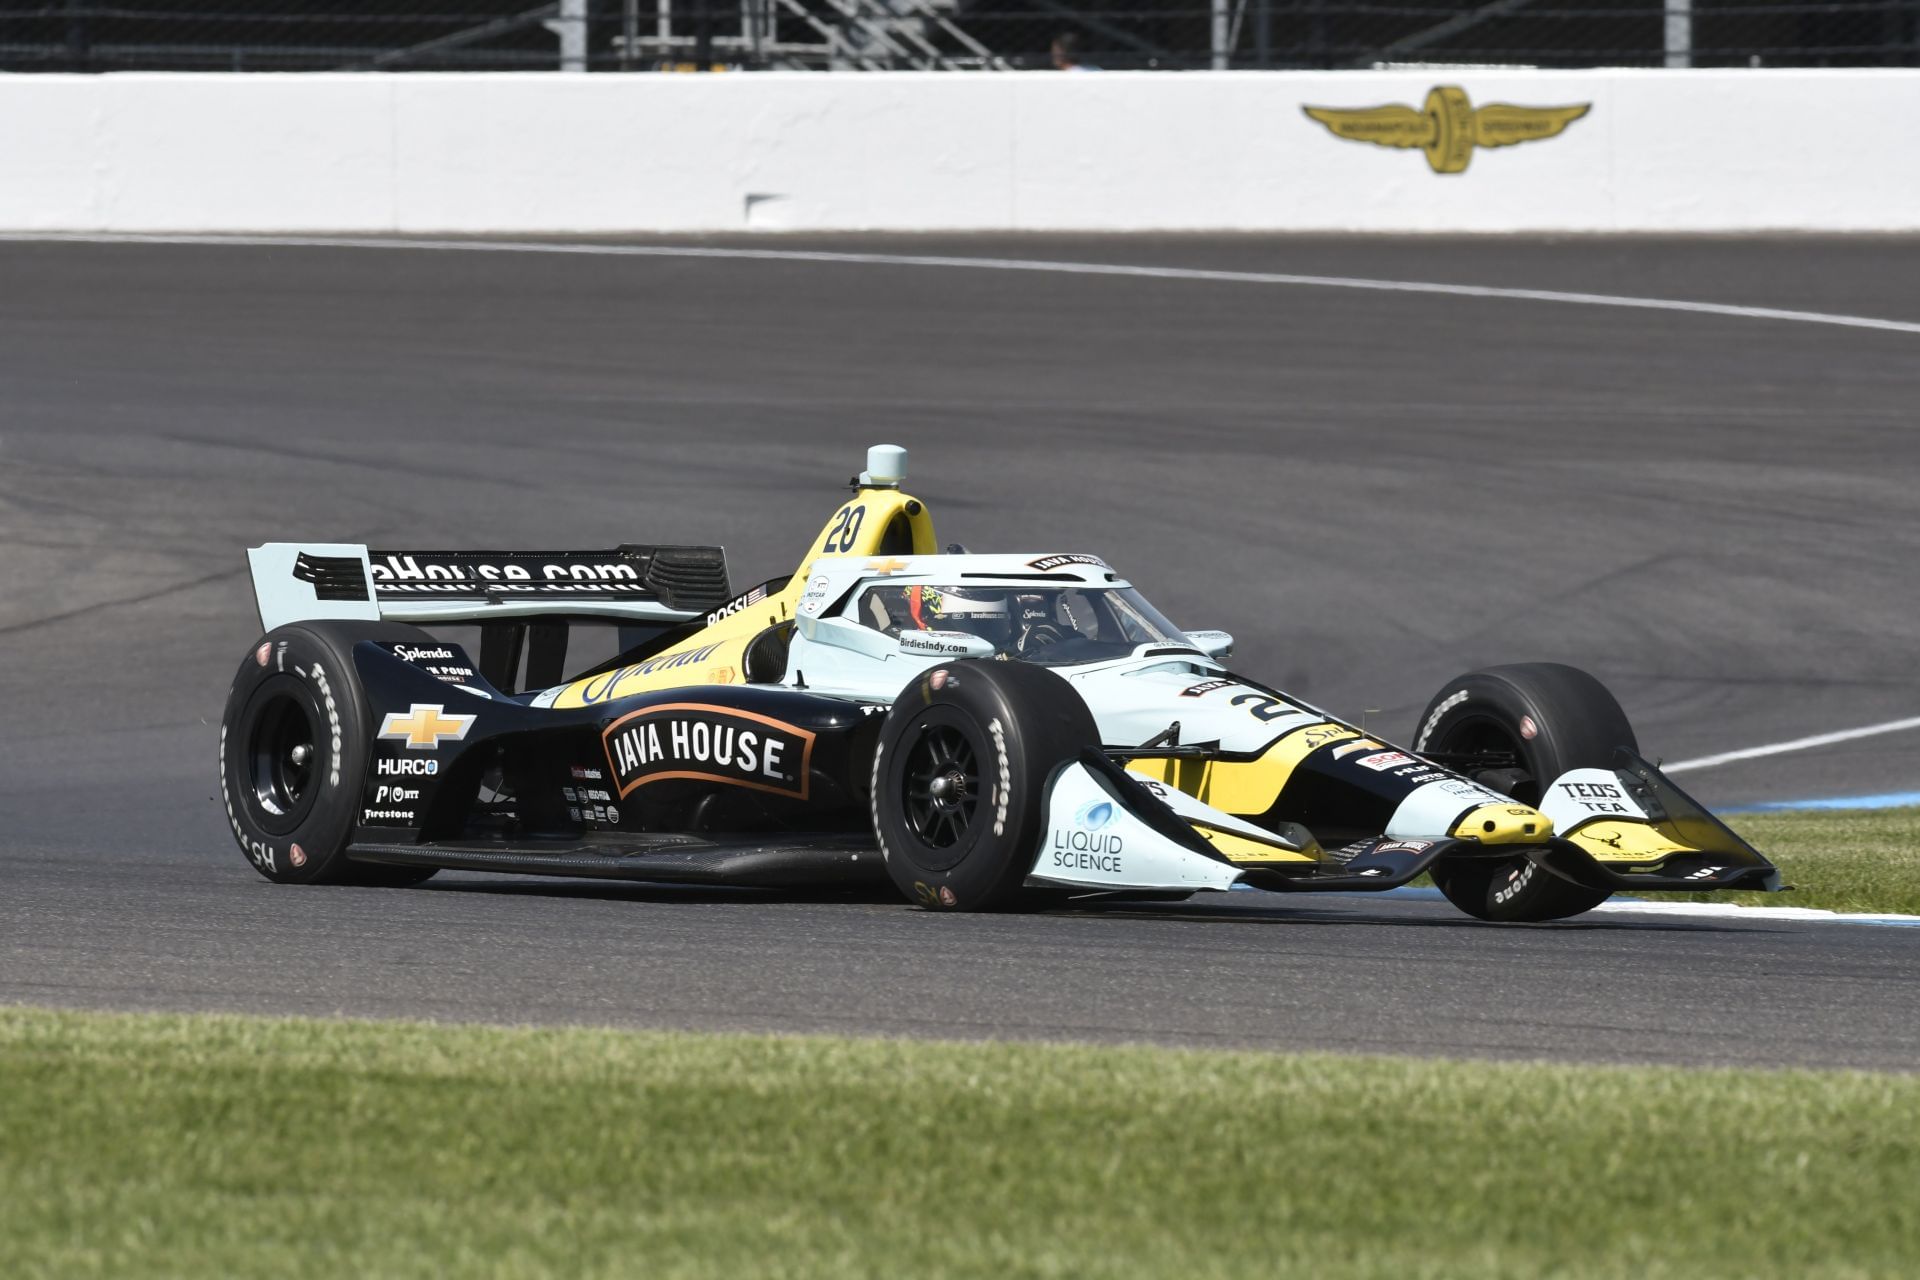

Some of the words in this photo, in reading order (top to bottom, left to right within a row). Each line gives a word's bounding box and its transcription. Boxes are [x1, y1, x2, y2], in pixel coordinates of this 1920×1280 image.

[822, 504, 866, 554] 20
[370, 555, 647, 592] aHouse.com
[393, 645, 455, 662] Splenda
[900, 637, 968, 654] BirdiesIndy.com
[440, 666, 474, 677] POUR
[1230, 693, 1302, 722] 2
[614, 723, 664, 777] JAVA
[671, 720, 785, 780] HOUSE
[377, 758, 439, 776] HURCO
[404, 790, 420, 799] NTT
[1557, 782, 1622, 799] TED'S
[364, 809, 415, 820] Firestone
[1579, 801, 1630, 813] TEA
[1054, 829, 1124, 855] LIQUID
[1053, 850, 1122, 873] SCIENCE
